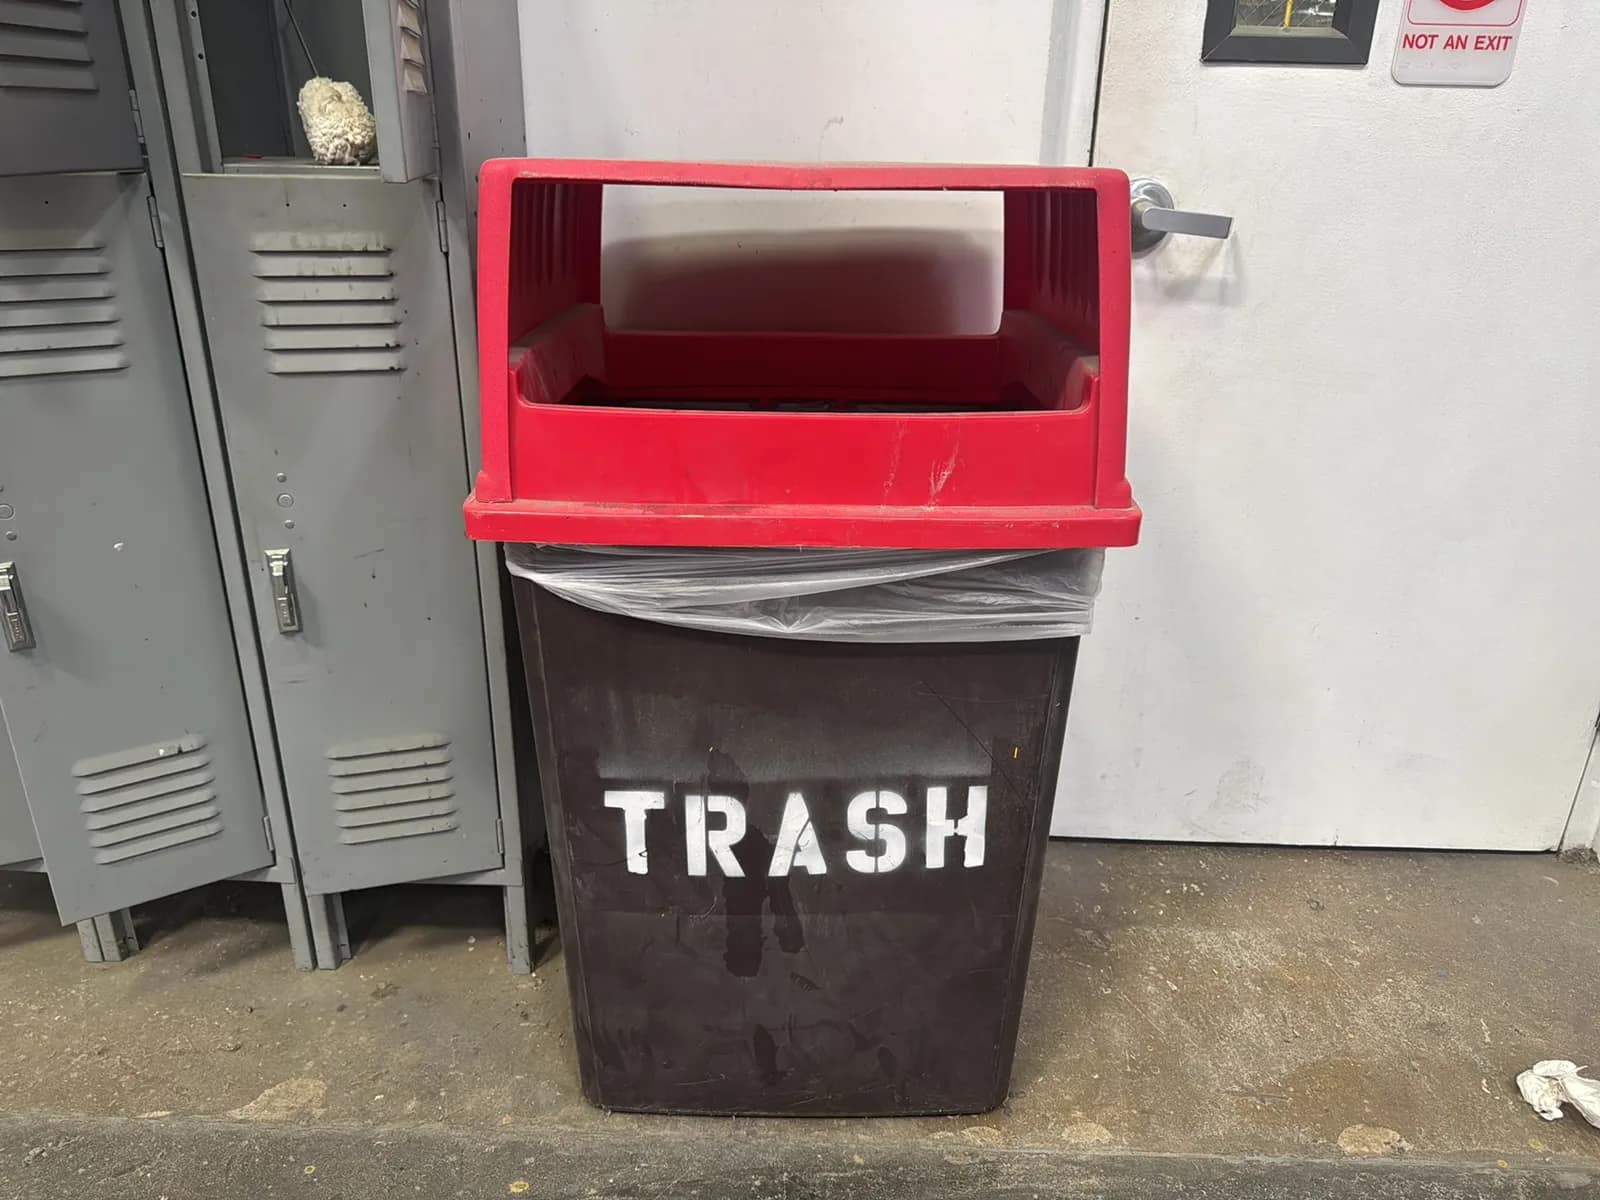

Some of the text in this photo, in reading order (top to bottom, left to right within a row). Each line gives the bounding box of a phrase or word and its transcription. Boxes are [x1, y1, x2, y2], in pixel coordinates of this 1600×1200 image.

[1402, 34, 1513, 51] NOT AN EXIT
[603, 785, 989, 878] TRASH
